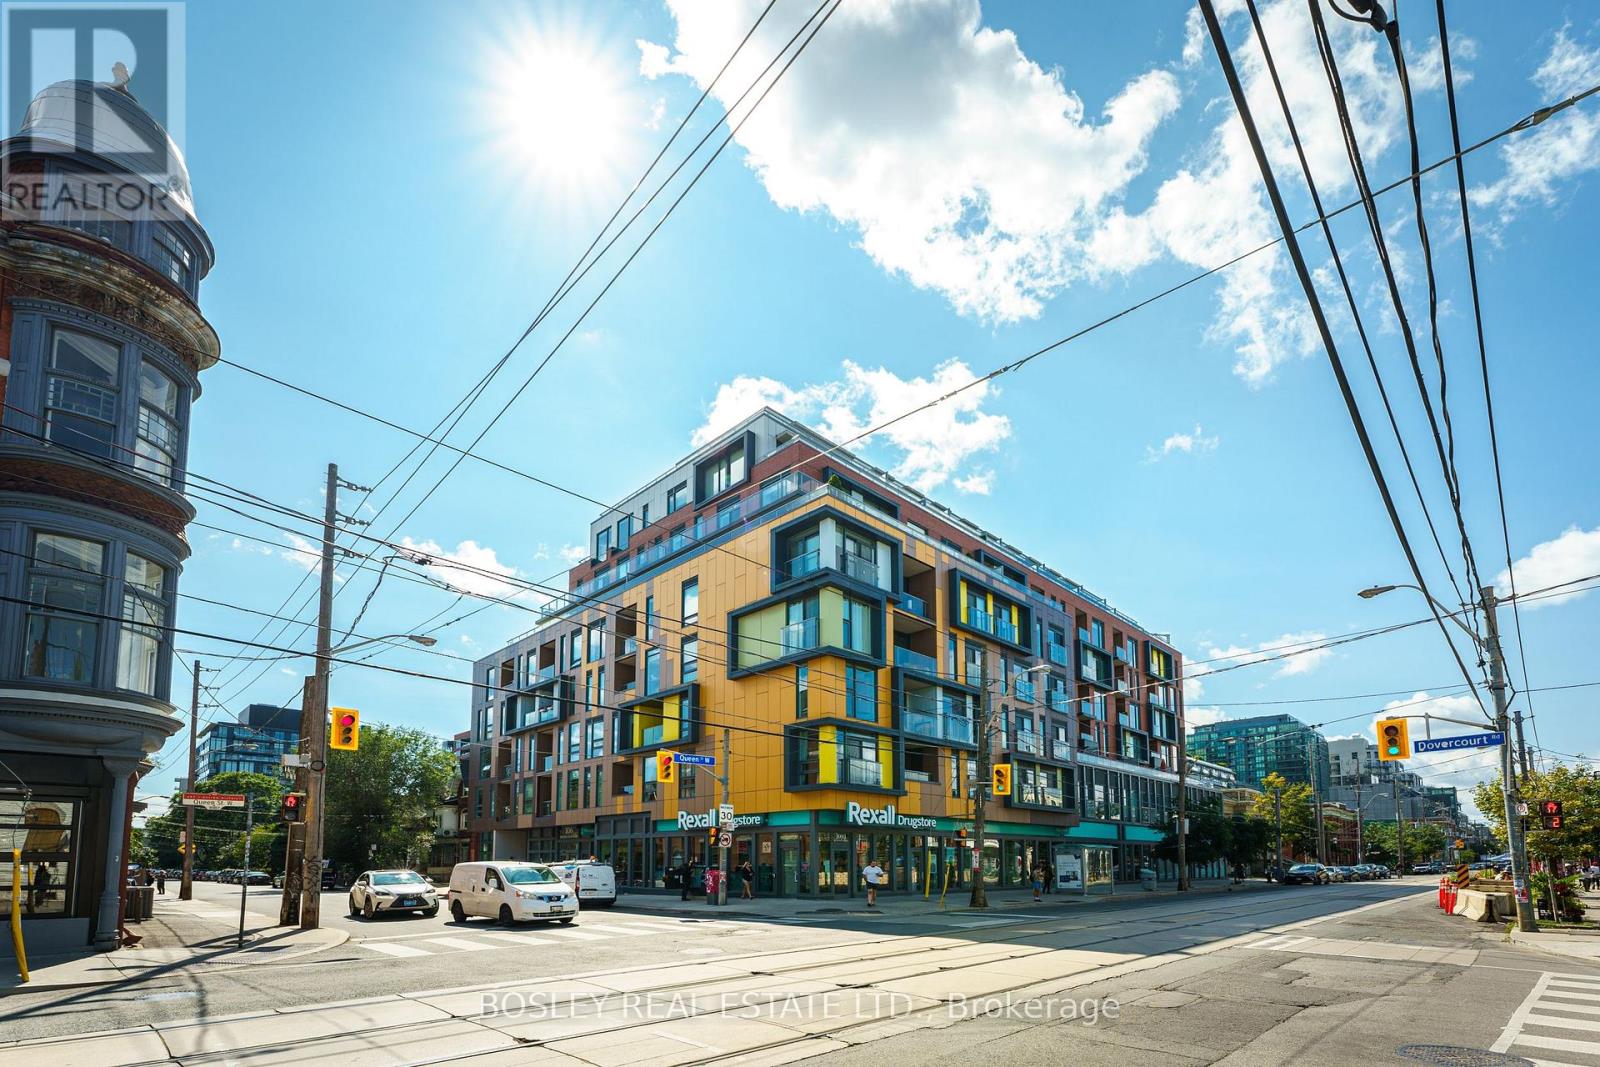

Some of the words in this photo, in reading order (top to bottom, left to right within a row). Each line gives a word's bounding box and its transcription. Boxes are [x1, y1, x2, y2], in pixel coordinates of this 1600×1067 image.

[1418, 736, 1488, 751] Dovercourt
[679, 754, 699, 763] Queen
[677, 808, 716, 830] Rexall
[720, 811, 733, 821] 30
[848, 801, 896, 826] Rexall
[898, 815, 937, 829] Drugstore
[1552, 817, 1560, 828] 2
